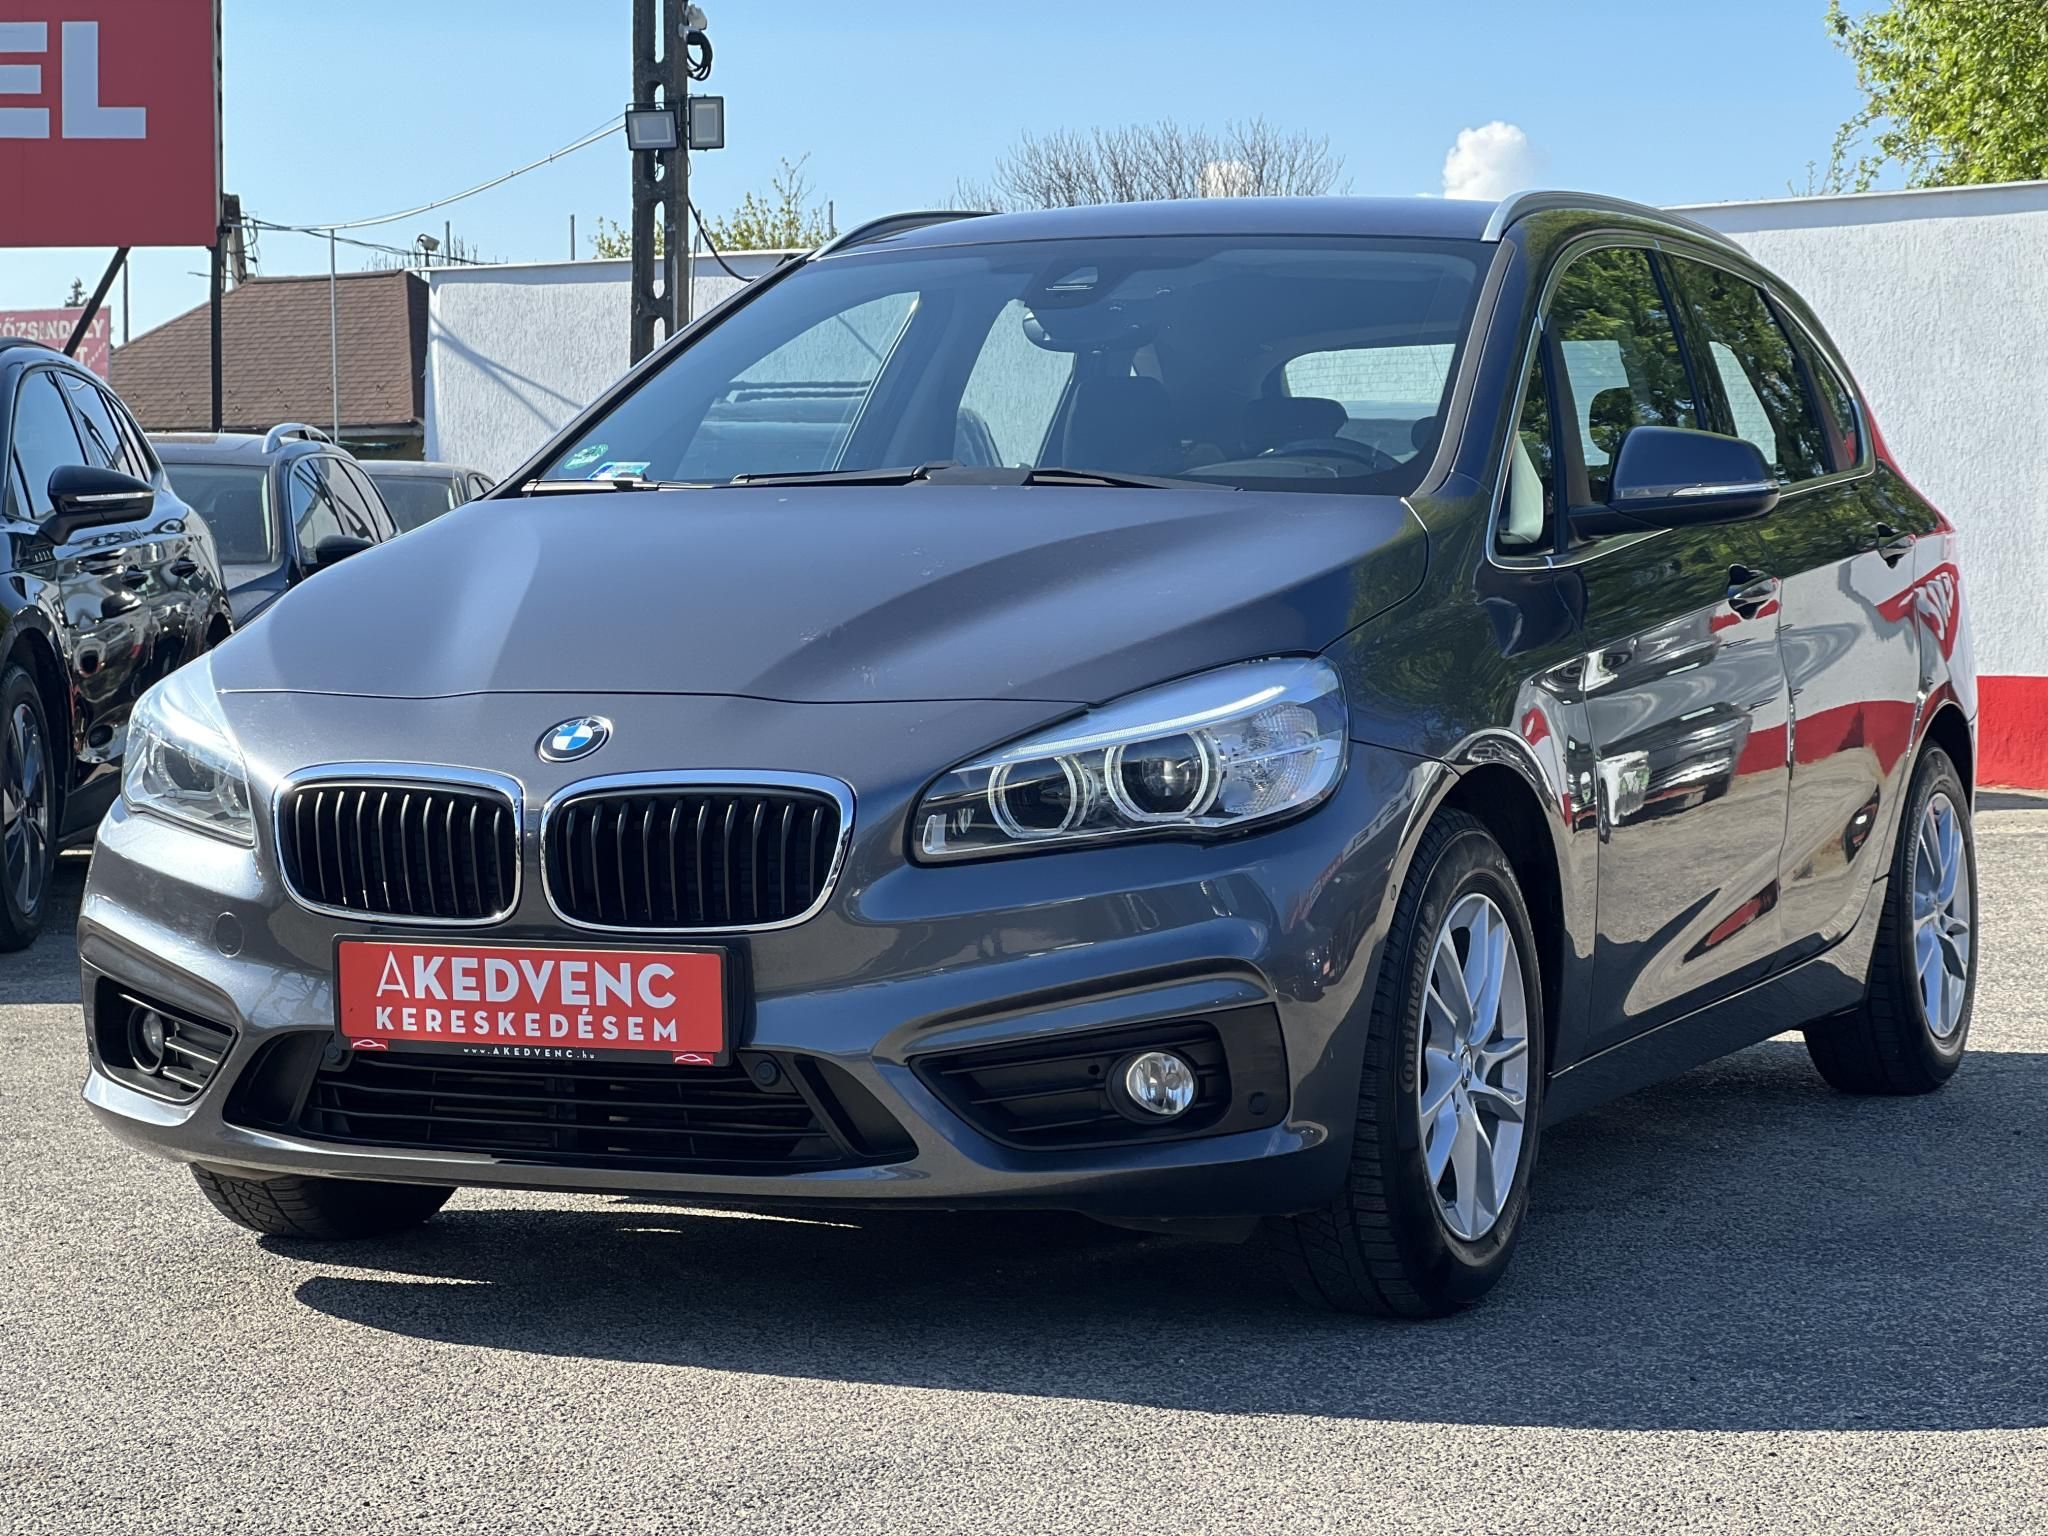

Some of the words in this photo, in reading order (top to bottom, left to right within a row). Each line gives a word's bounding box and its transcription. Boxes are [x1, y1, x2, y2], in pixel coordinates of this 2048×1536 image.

[376, 1007, 678, 1042] KERESKEDÉSEM
[1399, 921, 1432, 1094] Continental
[463, 1047, 596, 1060] www.AKEDVENC.hu
